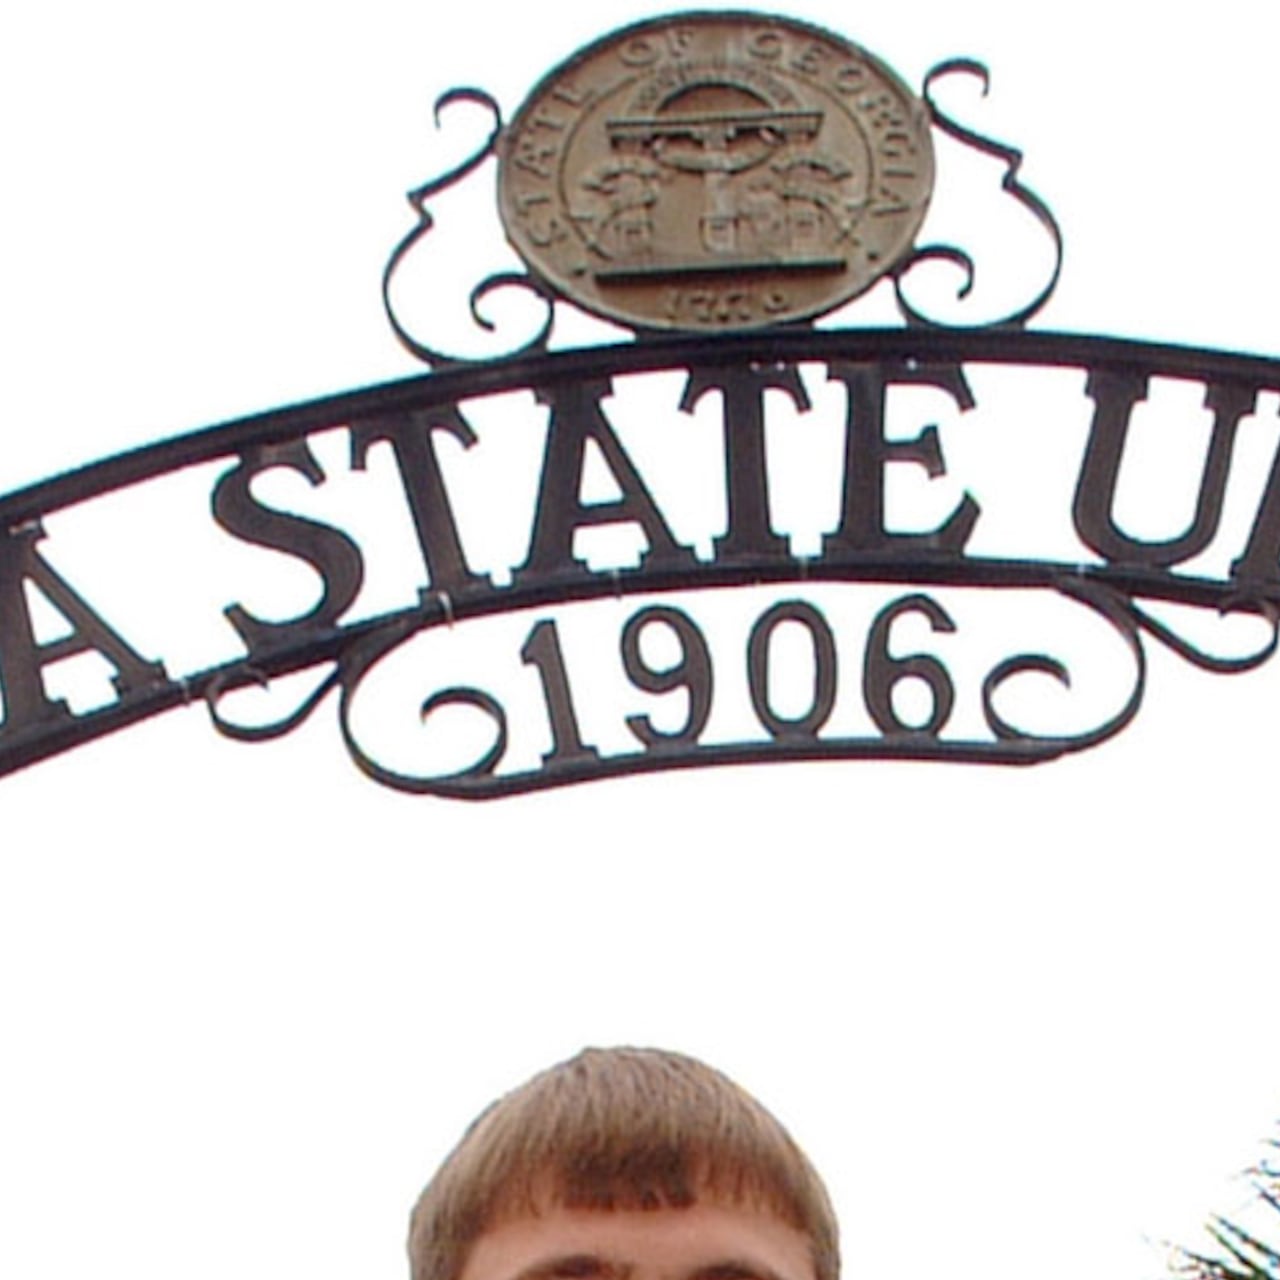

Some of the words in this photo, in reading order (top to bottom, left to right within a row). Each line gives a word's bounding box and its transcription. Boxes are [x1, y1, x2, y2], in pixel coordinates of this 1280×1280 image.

[513, 82, 598, 248] STATE
[618, 28, 695, 68] OF
[748, 31, 920, 219] GEORGIA
[210, 360, 981, 656] STATE
[520, 593, 957, 769] 1906
